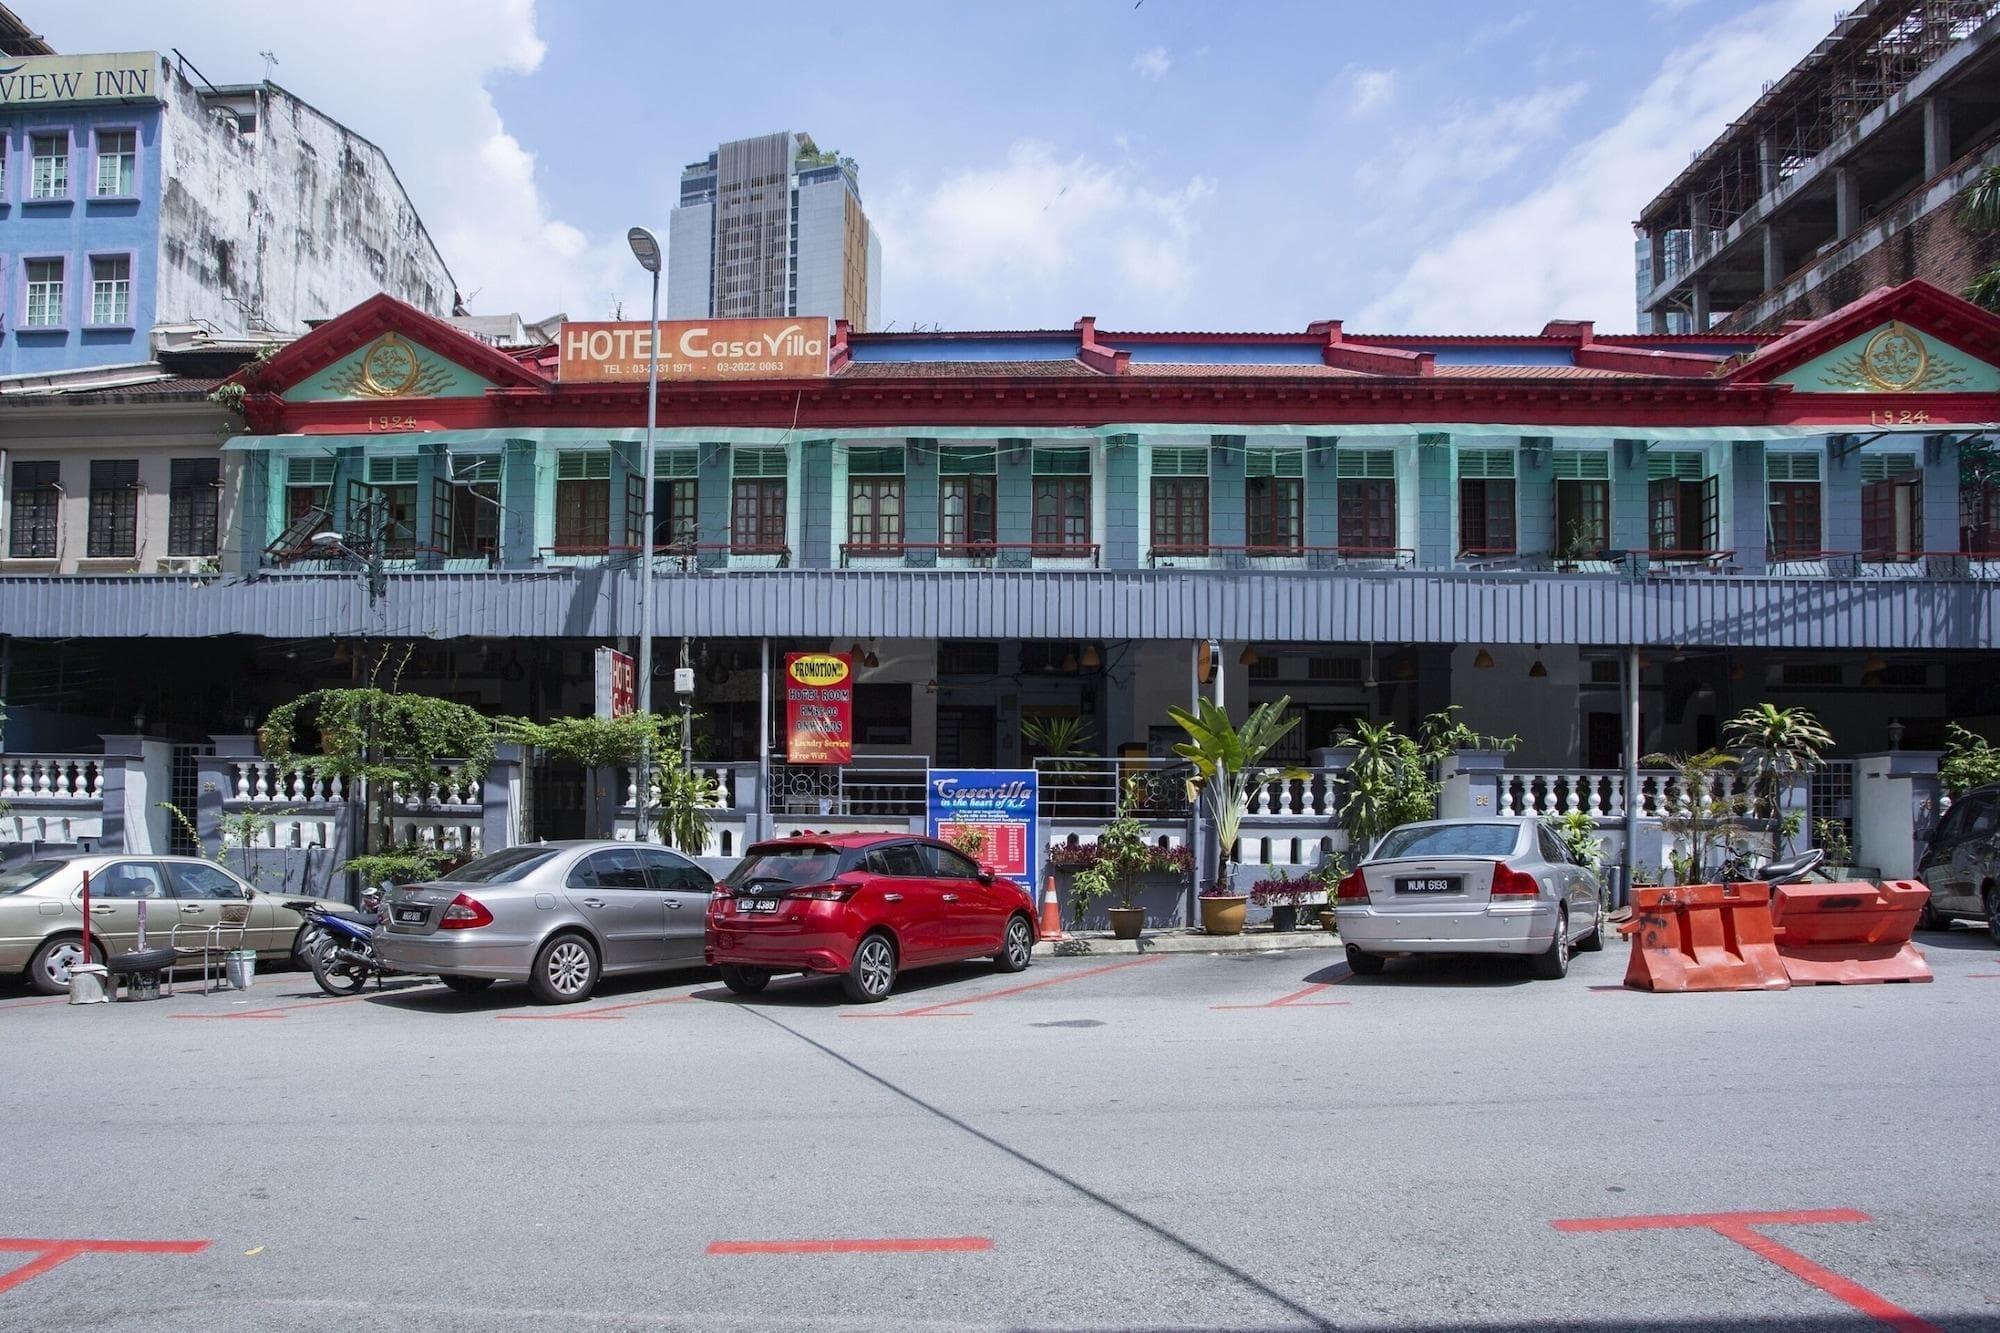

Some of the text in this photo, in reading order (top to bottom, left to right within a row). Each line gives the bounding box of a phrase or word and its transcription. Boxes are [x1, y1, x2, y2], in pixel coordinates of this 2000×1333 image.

[0, 69, 149, 101] VIEW INN
[567, 328, 673, 360] HOTEL
[603, 364, 622, 374] TEL
[672, 363, 692, 373] 1971
[717, 362, 756, 372] 03-2022
[759, 361, 784, 371] 0063
[368, 416, 417, 431] 1924
[1871, 410, 1929, 424] 1924
[613, 659, 632, 693] HOTEL
[788, 688, 849, 701] HOTEL ROOM
[824, 740, 849, 748] Service
[794, 752, 810, 760] Free
[940, 799, 951, 807] in
[952, 798, 968, 807] the
[970, 798, 993, 807] heart
[995, 797, 1006, 810] of
[1407, 880, 1448, 891] WUM 6193
